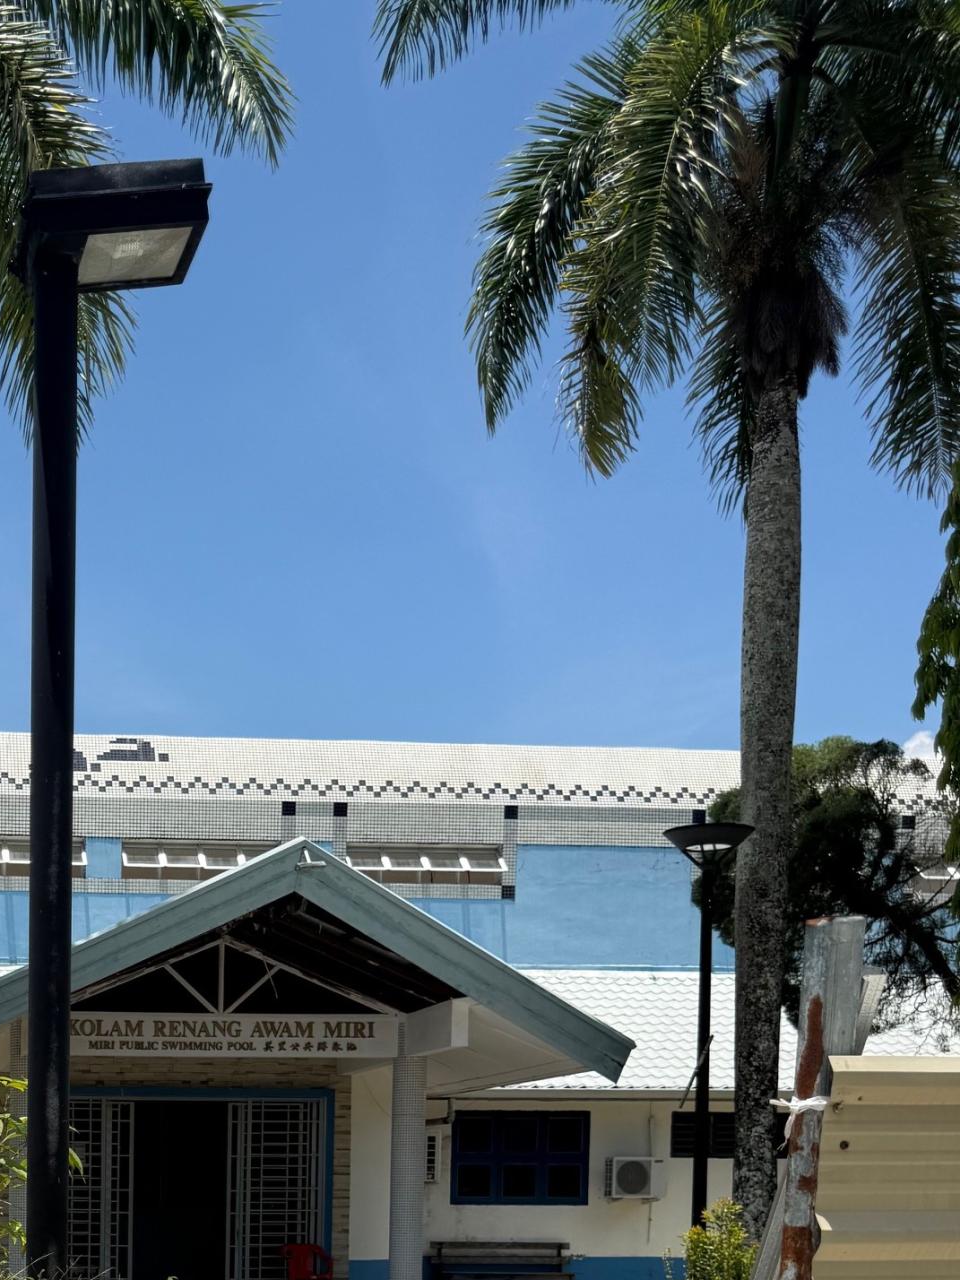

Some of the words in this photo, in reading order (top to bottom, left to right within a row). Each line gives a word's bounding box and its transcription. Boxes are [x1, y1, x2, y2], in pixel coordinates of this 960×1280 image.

[70, 1019, 144, 1037] KOLAM
[152, 1020, 242, 1038] RENANG
[250, 1021, 315, 1038] AWAM
[323, 1021, 376, 1039] MIRI
[88, 1040, 115, 1050] MIRI
[120, 1041, 159, 1051] PUBLIC
[161, 1041, 223, 1051] SWIMMING
[227, 1041, 257, 1051] POOL
